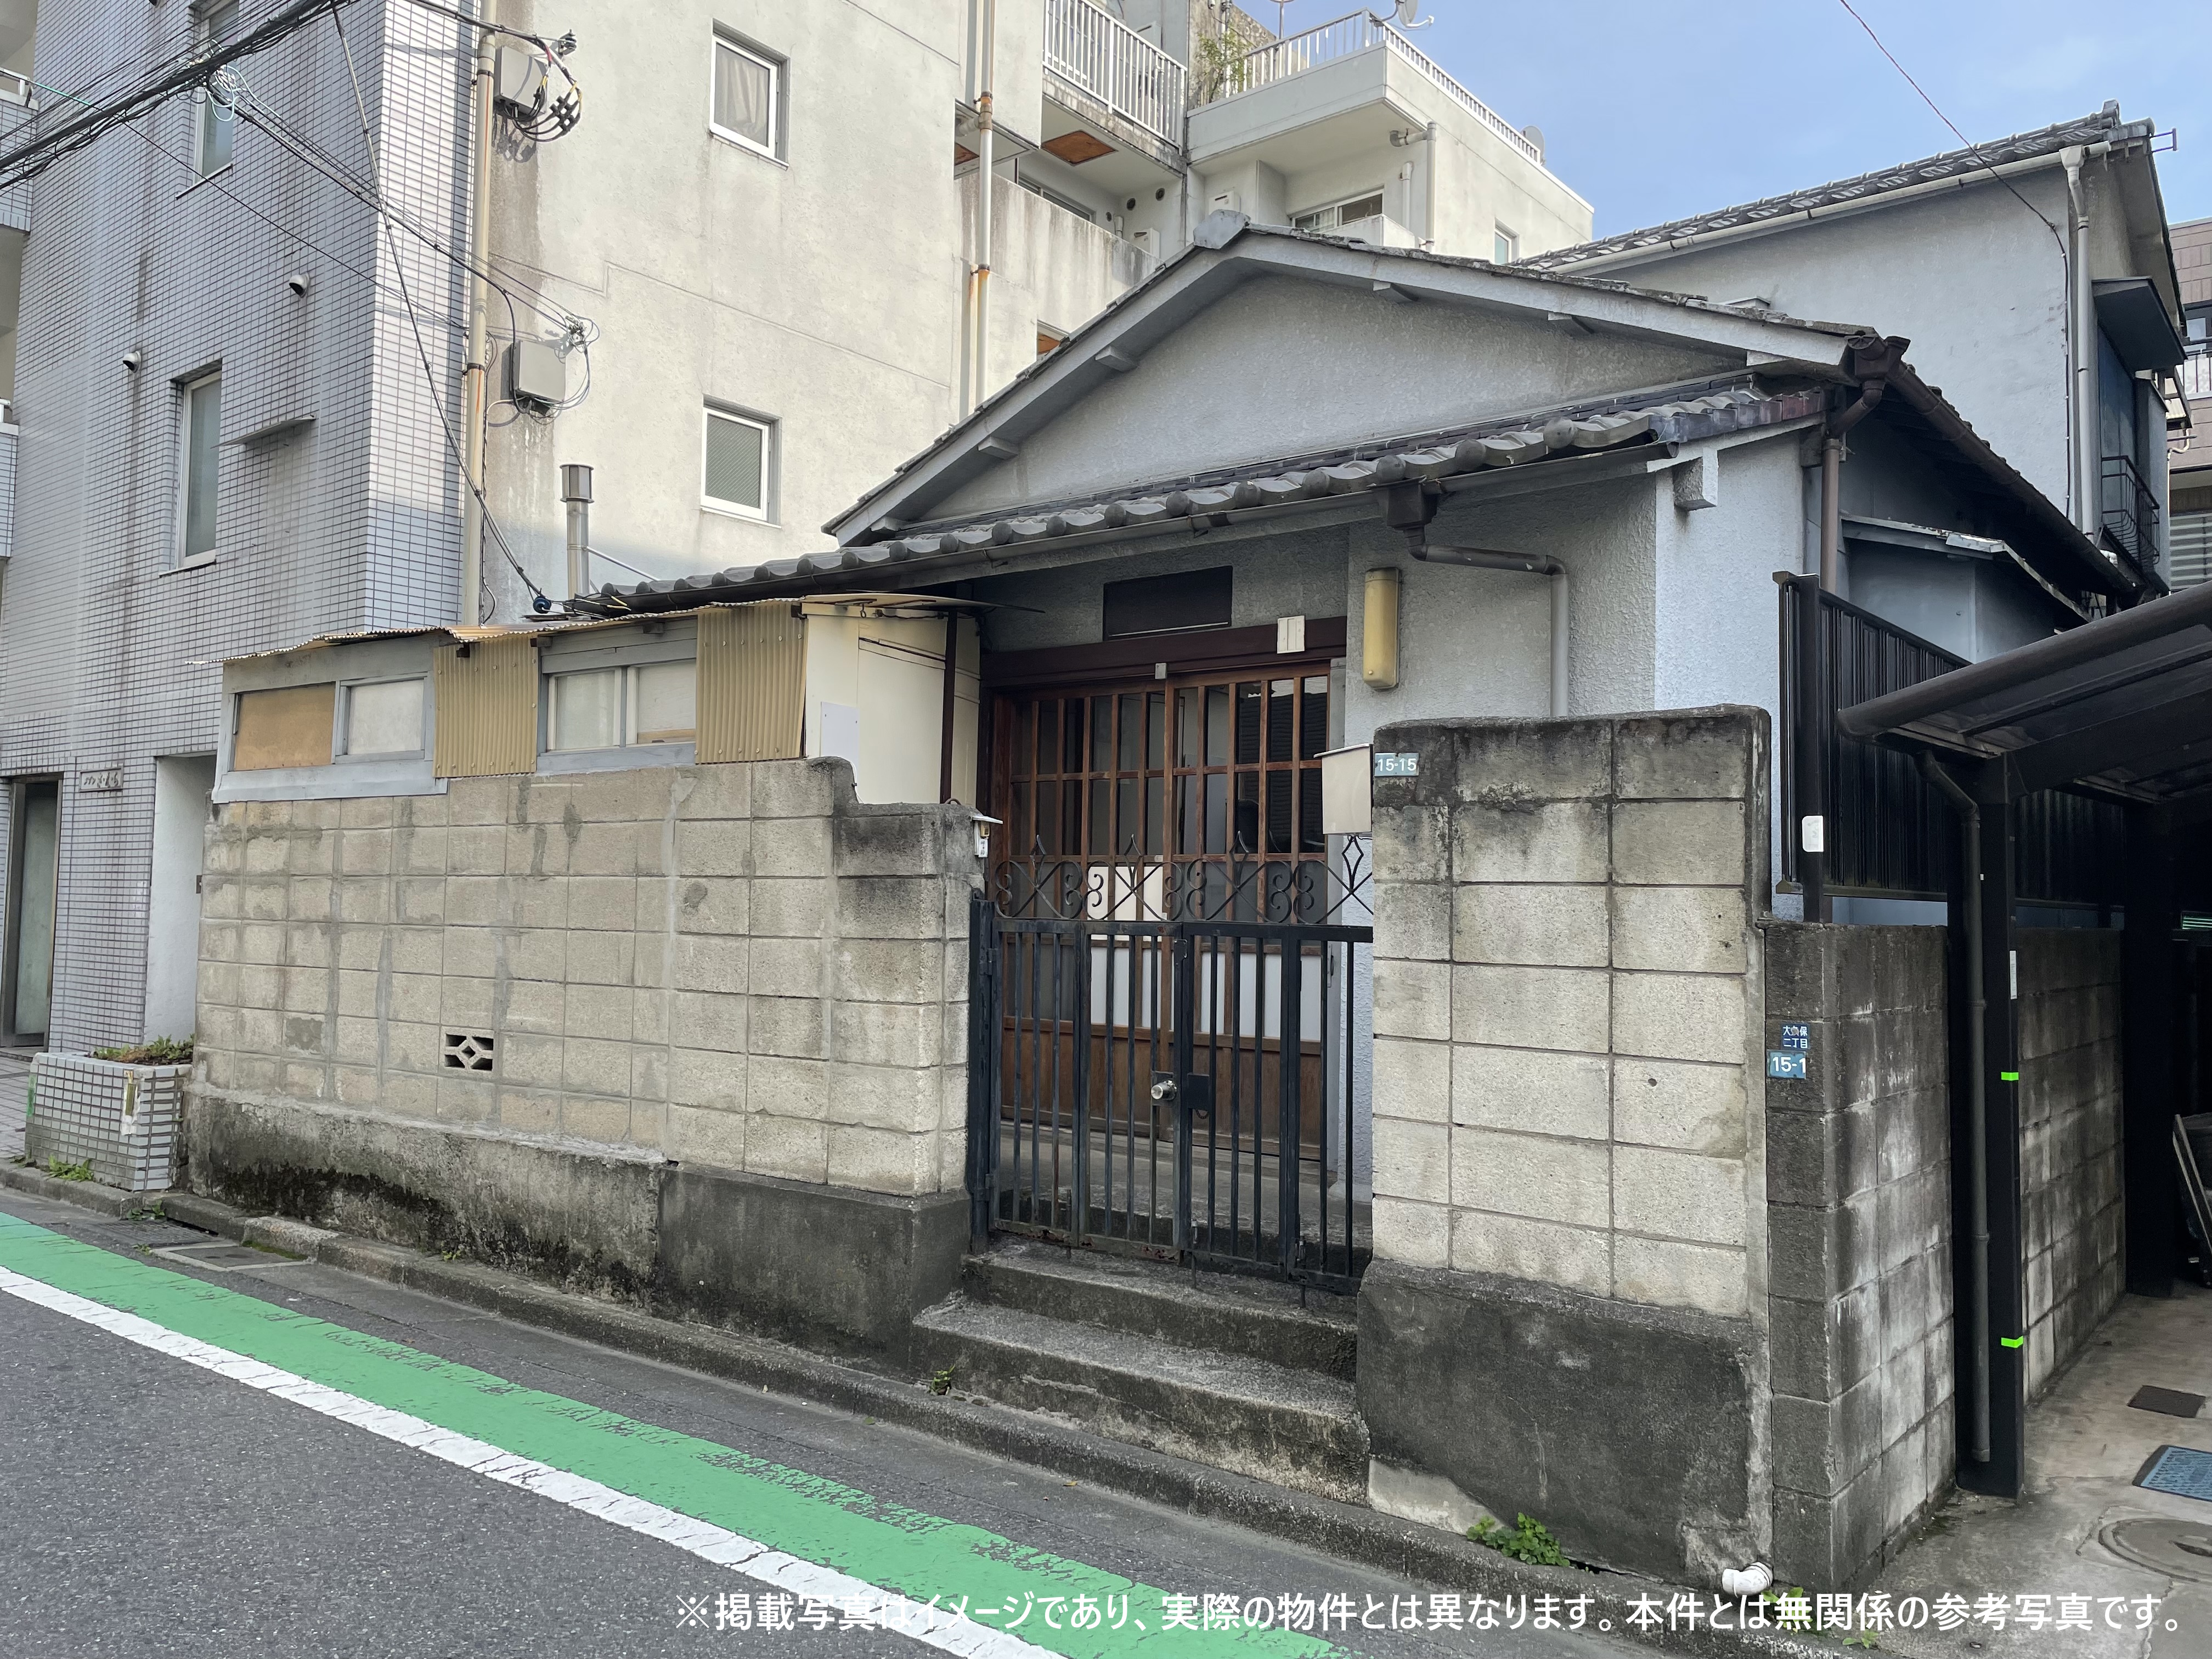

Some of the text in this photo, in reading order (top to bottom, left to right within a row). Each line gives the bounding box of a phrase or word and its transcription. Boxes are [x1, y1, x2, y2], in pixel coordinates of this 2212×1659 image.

[1378, 758, 1417, 772] 15-15
[1783, 1037, 1808, 1049] 二丁目
[1772, 1056, 1806, 1074] 15-1
